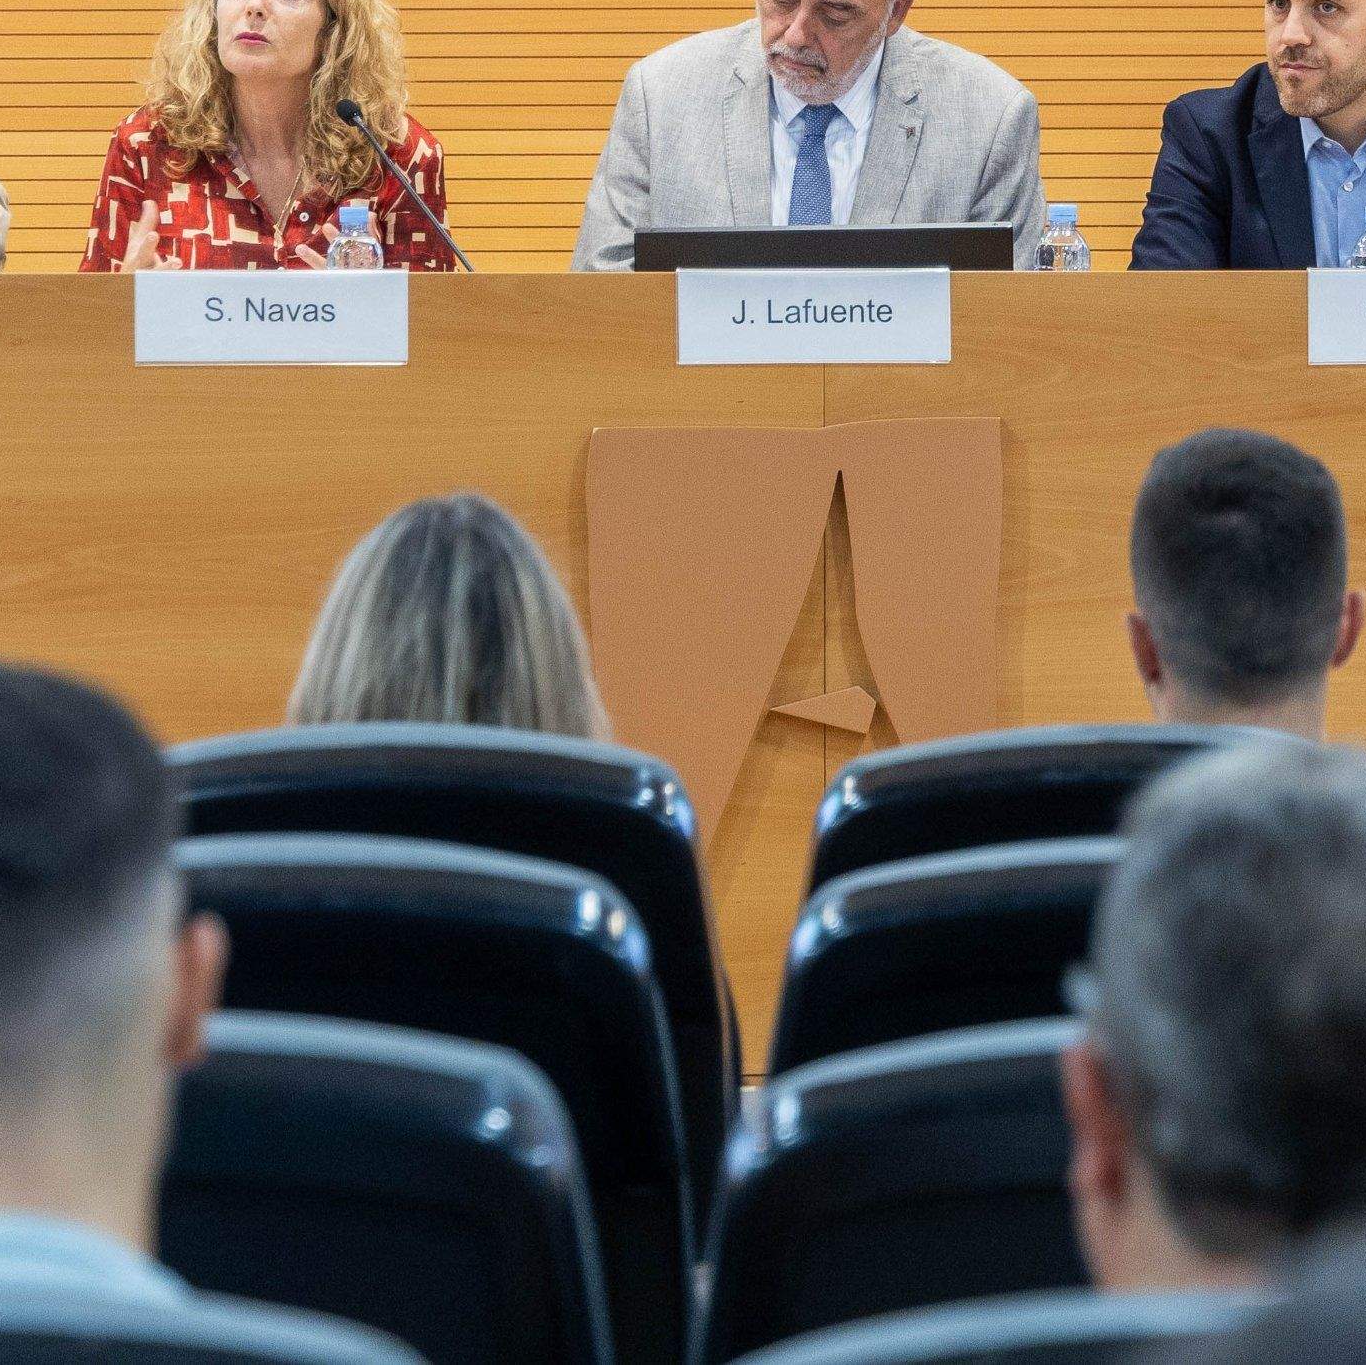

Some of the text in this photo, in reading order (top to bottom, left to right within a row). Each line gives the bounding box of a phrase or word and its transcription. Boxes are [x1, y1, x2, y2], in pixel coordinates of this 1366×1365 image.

[204, 296, 336, 323] S. Navas
[731, 298, 893, 325] J. Lafuente
